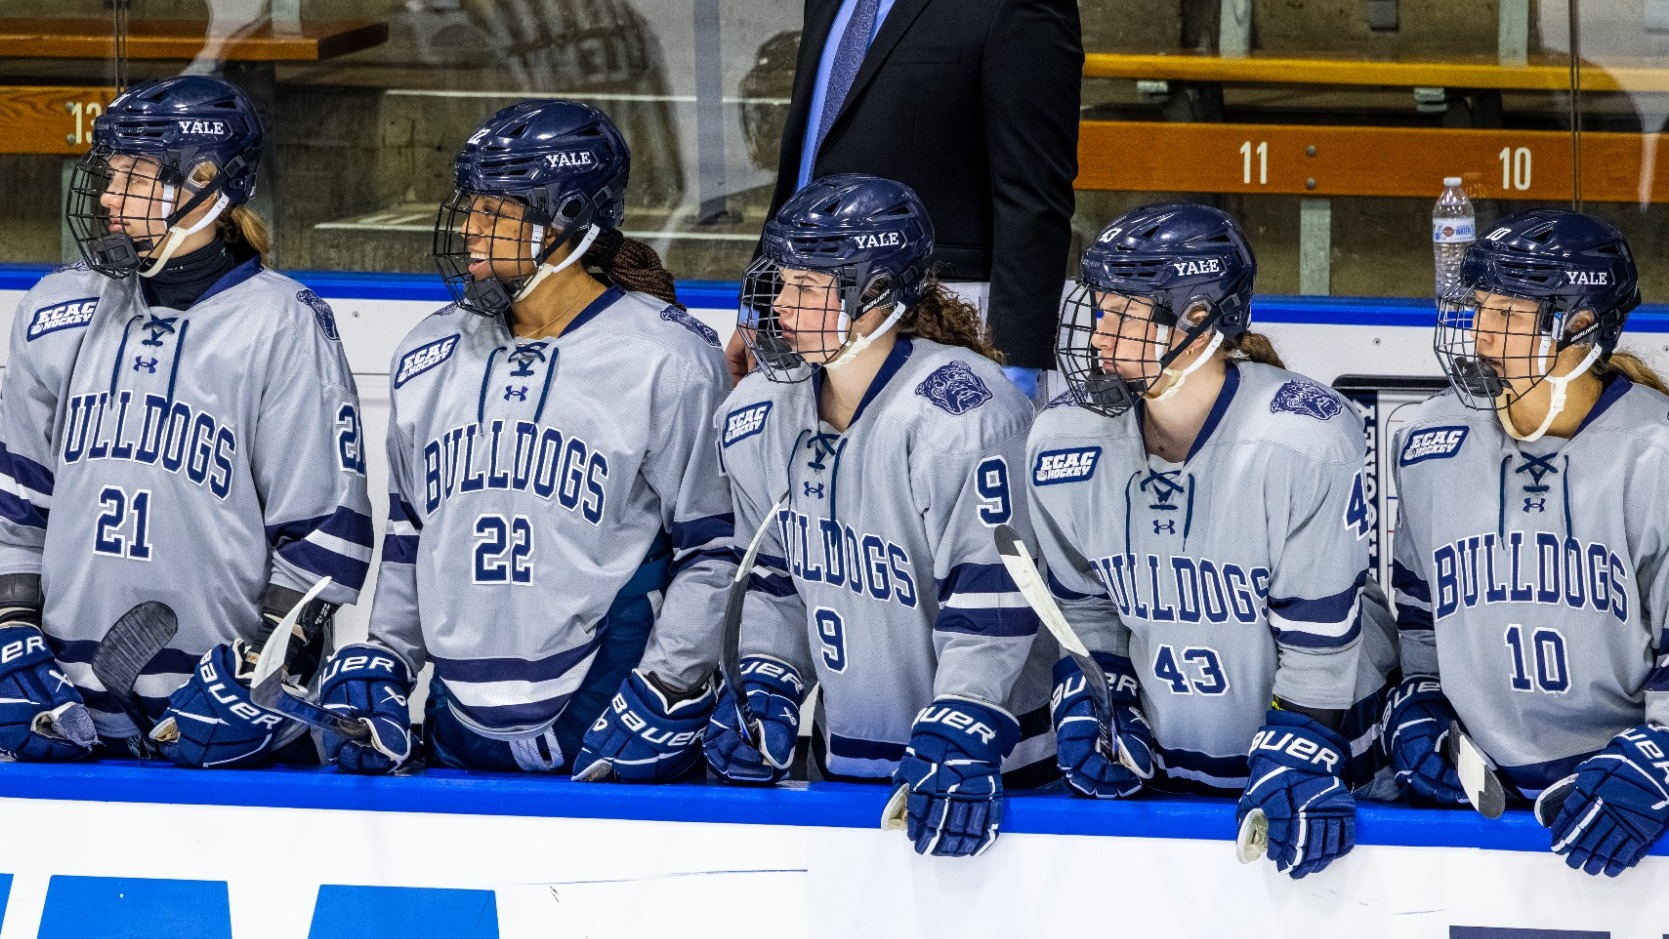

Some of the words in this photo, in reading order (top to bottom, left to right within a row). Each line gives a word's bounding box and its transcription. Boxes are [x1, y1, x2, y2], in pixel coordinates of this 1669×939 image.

[178, 121, 224, 135] YALE
[546, 151, 592, 168] YALE
[1240, 140, 1269, 185] 11
[1498, 146, 1532, 192] 10
[853, 231, 900, 250] YALE
[1173, 258, 1220, 277] YALE
[1566, 271, 1608, 286] YALE
[38, 301, 98, 324] ECAC
[403, 338, 455, 371] ECAC
[729, 405, 768, 432] ECAC
[1409, 430, 1464, 449] ECAC
[1414, 443, 1457, 458] HOCKEY
[423, 418, 609, 527] BULLDOGS
[1040, 451, 1096, 471] ECAC
[1047, 465, 1091, 480] HOCKEY
[974, 454, 1013, 528] 9
[93, 484, 152, 562] 21
[471, 513, 534, 587] 22
[1432, 530, 1629, 625] BULLDOGS
[813, 605, 849, 675] 9
[1153, 643, 1230, 696] 43
[1504, 623, 1572, 695] 10
